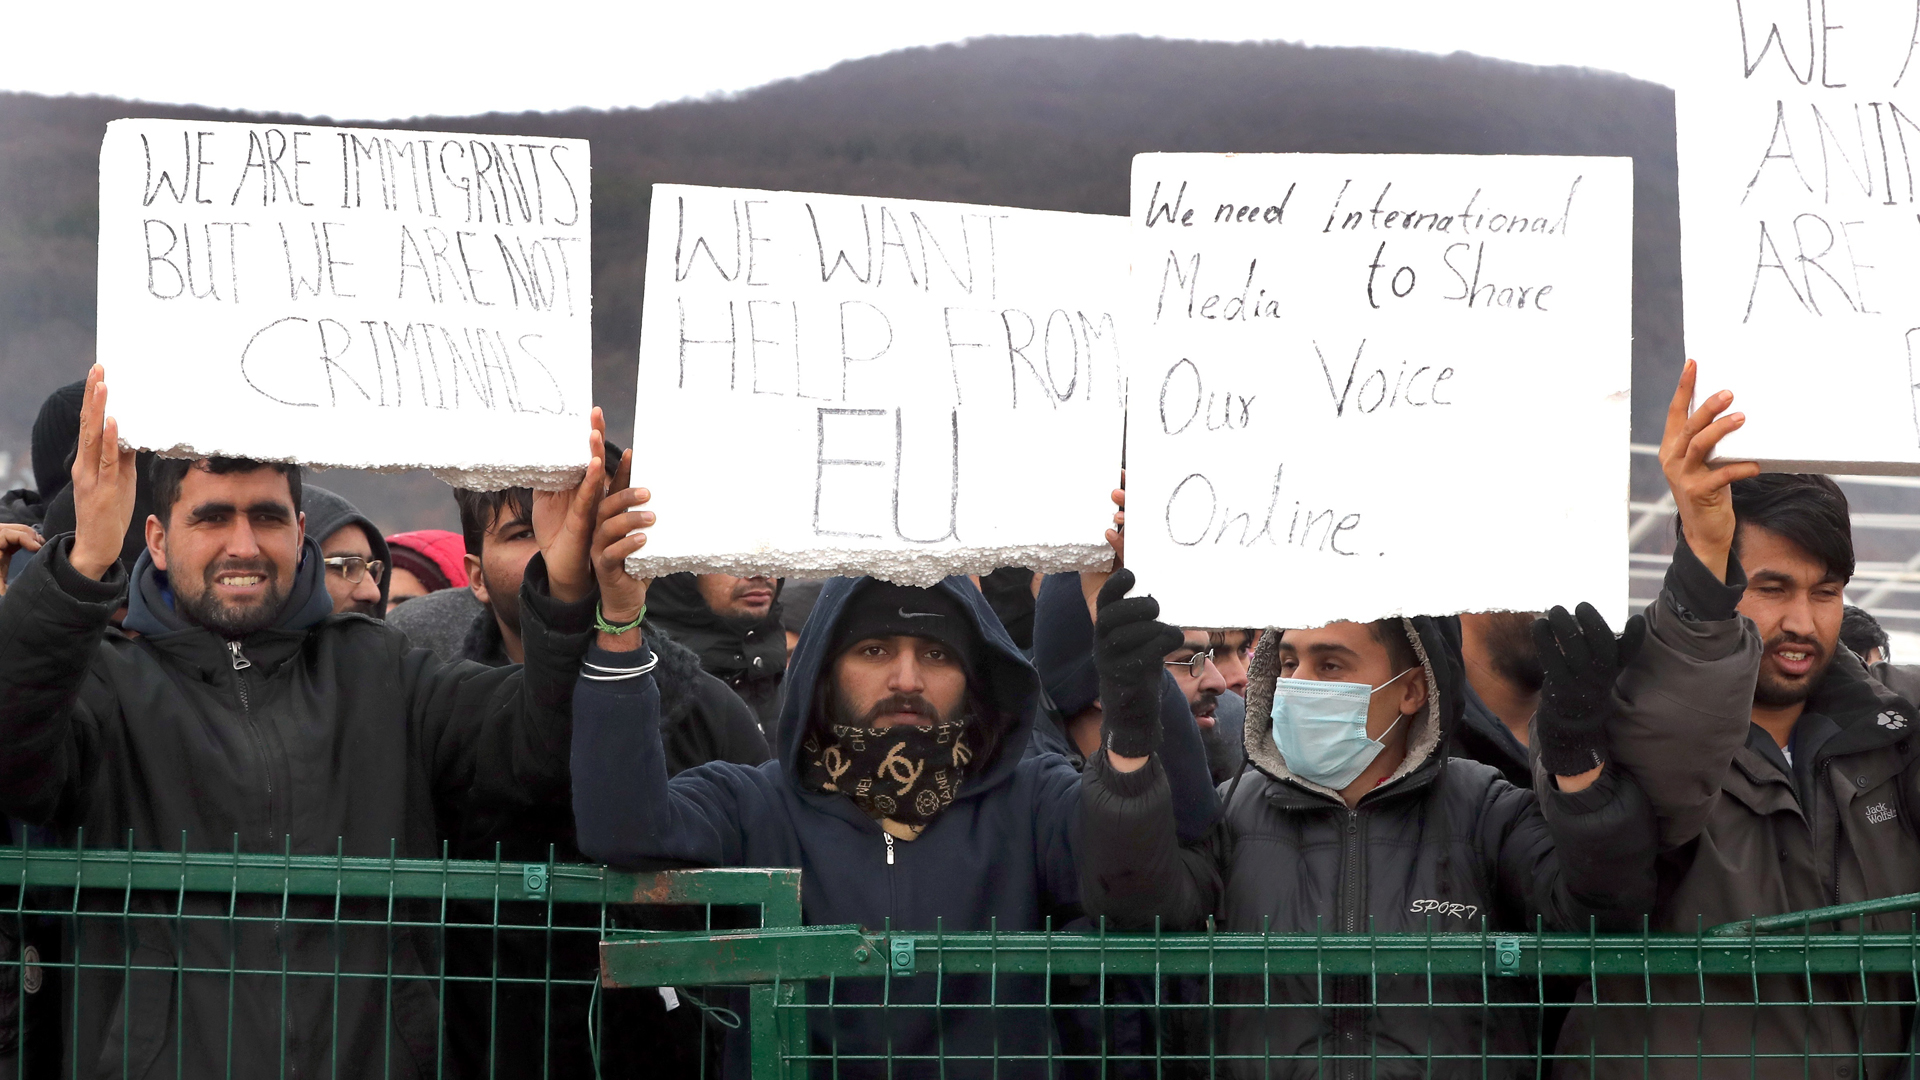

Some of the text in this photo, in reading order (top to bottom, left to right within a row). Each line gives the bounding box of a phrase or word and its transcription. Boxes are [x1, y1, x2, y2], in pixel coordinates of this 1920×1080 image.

[1737, 0, 1847, 89] WE
[141, 131, 216, 206] WE
[232, 129, 314, 207] ARE
[1145, 174, 1584, 237] We need International
[143, 219, 583, 317] BUT WE ARE NOT
[675, 196, 1009, 300] WE WANT
[1153, 240, 1554, 325] Media to Share
[1743, 213, 1882, 324] ARE
[677, 296, 1125, 410] HELP FROM
[1159, 338, 1454, 436] Our Voice
[812, 406, 961, 544] EU
[1865, 802, 1888, 816] Jack
[1409, 899, 1478, 920] SPORT
